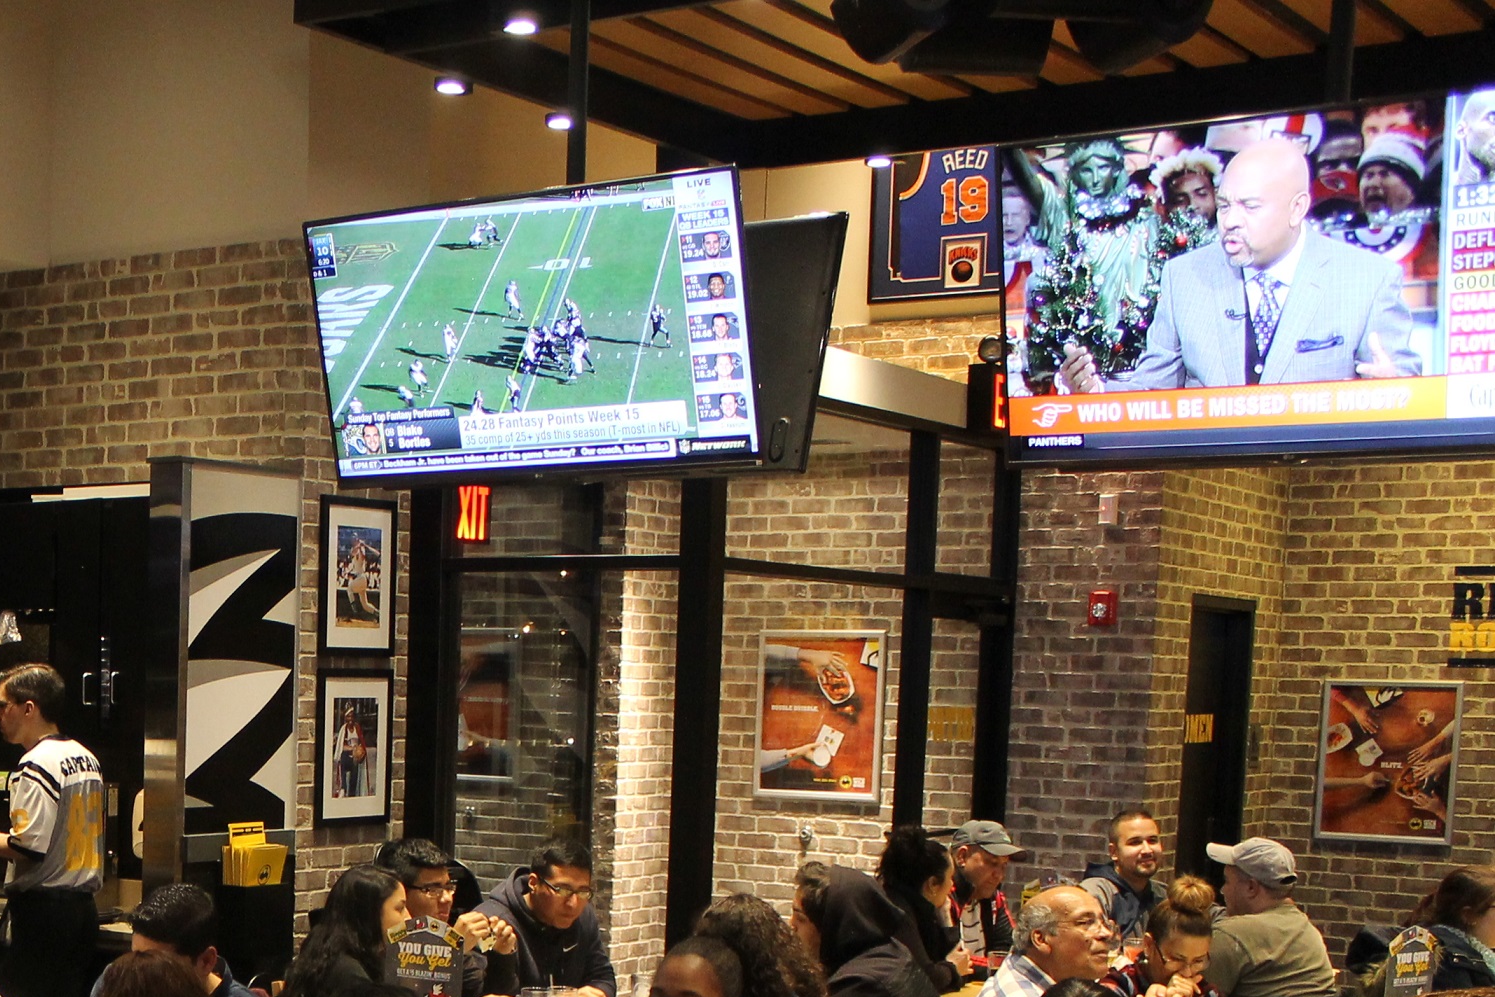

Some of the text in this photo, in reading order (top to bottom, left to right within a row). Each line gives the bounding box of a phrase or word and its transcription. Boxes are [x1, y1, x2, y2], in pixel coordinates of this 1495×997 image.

[942, 149, 989, 174] REED
[686, 178, 711, 188] LIVE
[941, 175, 989, 226] 19
[681, 208, 724, 221] WEEK 15
[693, 217, 729, 228] LEADERS
[686, 235, 693, 243] 11
[317, 246, 329, 257] 10
[683, 248, 704, 258] 19.24
[948, 246, 978, 265] KNICKS
[690, 275, 698, 284] 12
[688, 289, 709, 299] 19.02
[696, 370, 716, 379] 18.24
[1077, 387, 1411, 423] WHO WILL BE MISSED THE MOST?
[347, 406, 451, 425] Sunday Top Fantasy Performers
[463, 407, 640, 432] 24.28 Fantasy Points Week 15
[384, 424, 423, 437] QB Blake
[465, 421, 681, 446] 35 comp of 25+ yds this season (T-most in NFL)
[398, 436, 432, 449] Bortles
[691, 440, 747, 452] NETWORK
[1028, 434, 1082, 448] PANTHERS
[383, 458, 416, 468] Beckham
[418, 457, 427, 467] Jr.
[428, 456, 445, 465] have
[445, 455, 463, 464] been
[464, 453, 485, 463] taken
[486, 453, 499, 462] out
[499, 452, 507, 461] of
[508, 451, 521, 460] the
[522, 451, 543, 461] game
[543, 448, 576, 458] Sunday?
[580, 446, 596, 456] Our
[597, 444, 623, 455] coach,
[624, 443, 645, 453] Brian
[457, 485, 490, 541] XIT
[1185, 713, 1214, 744] MEN
[397, 941, 453, 958] YOU GIVE
[397, 952, 452, 971] You Get
[1396, 952, 1413, 965] YOU
